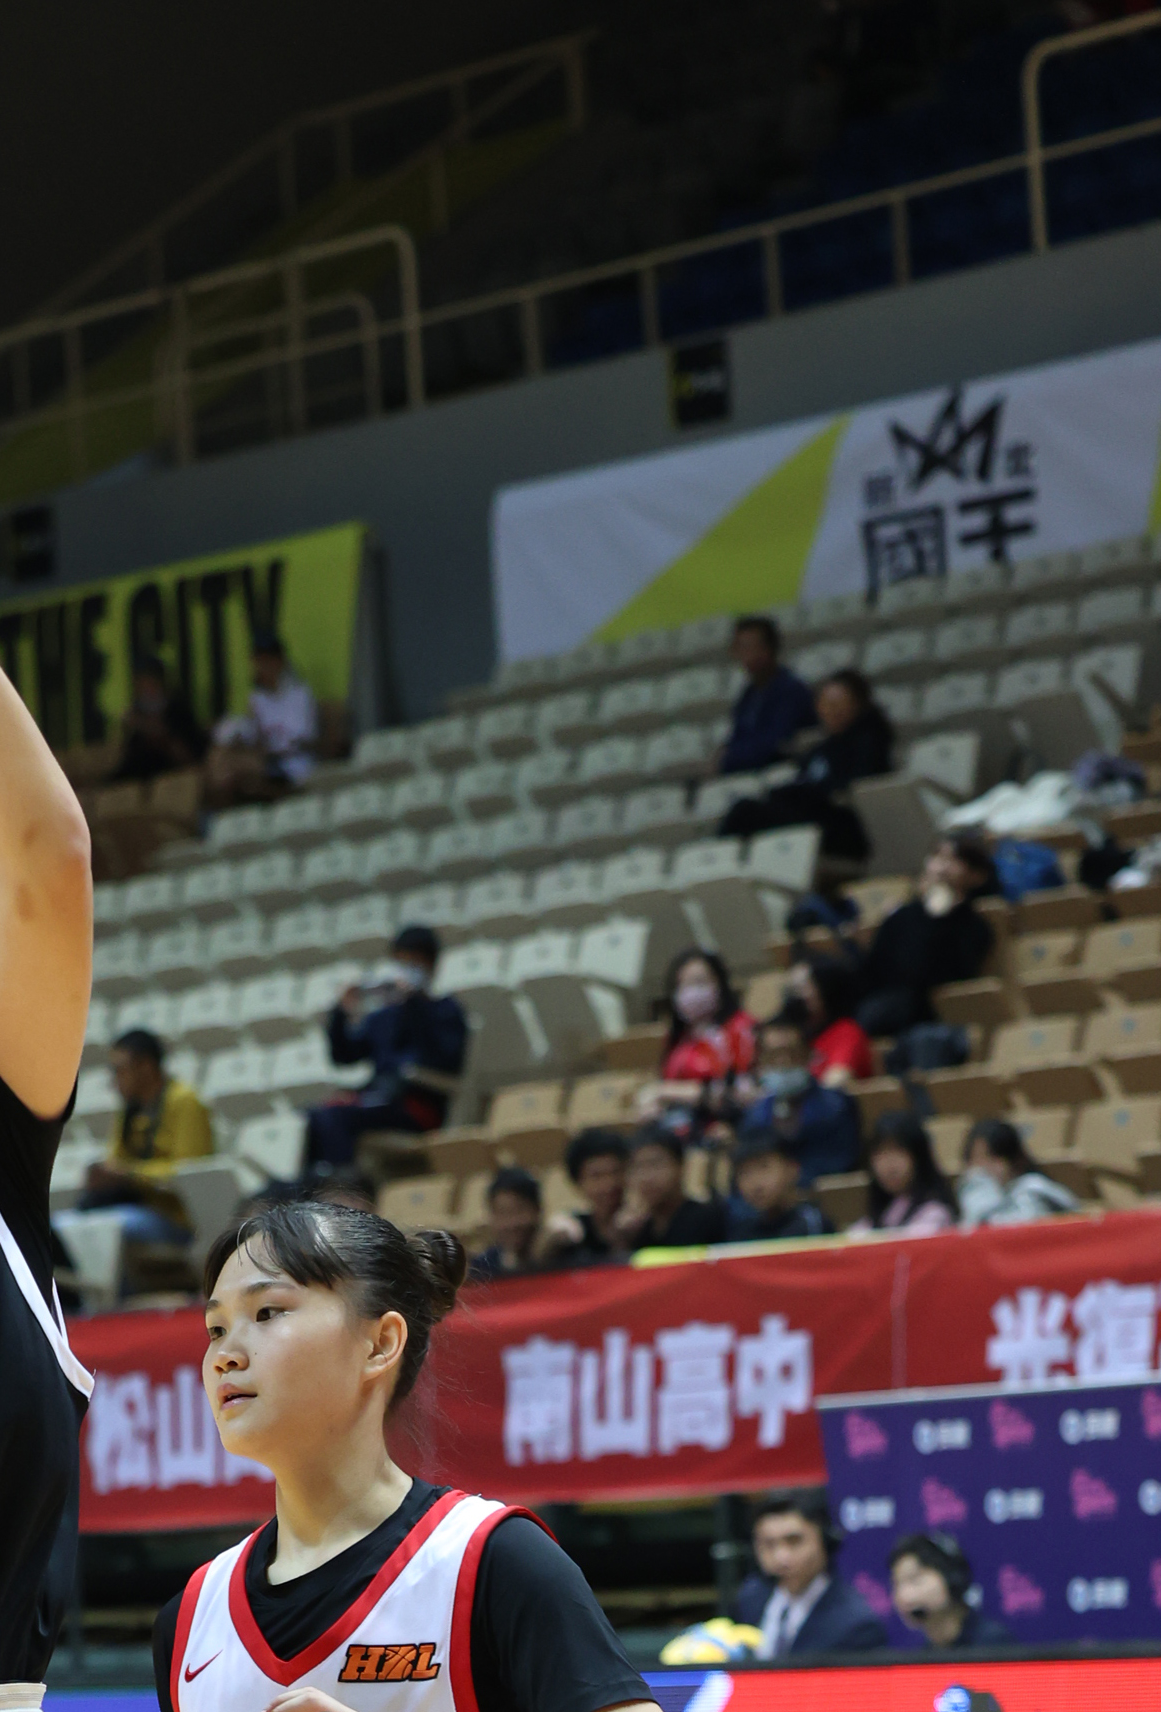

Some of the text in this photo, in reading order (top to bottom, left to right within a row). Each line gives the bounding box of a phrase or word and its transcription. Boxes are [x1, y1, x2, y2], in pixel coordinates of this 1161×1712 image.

[502, 1313, 813, 1467] 南山高中
[339, 1642, 442, 1682] HBL
